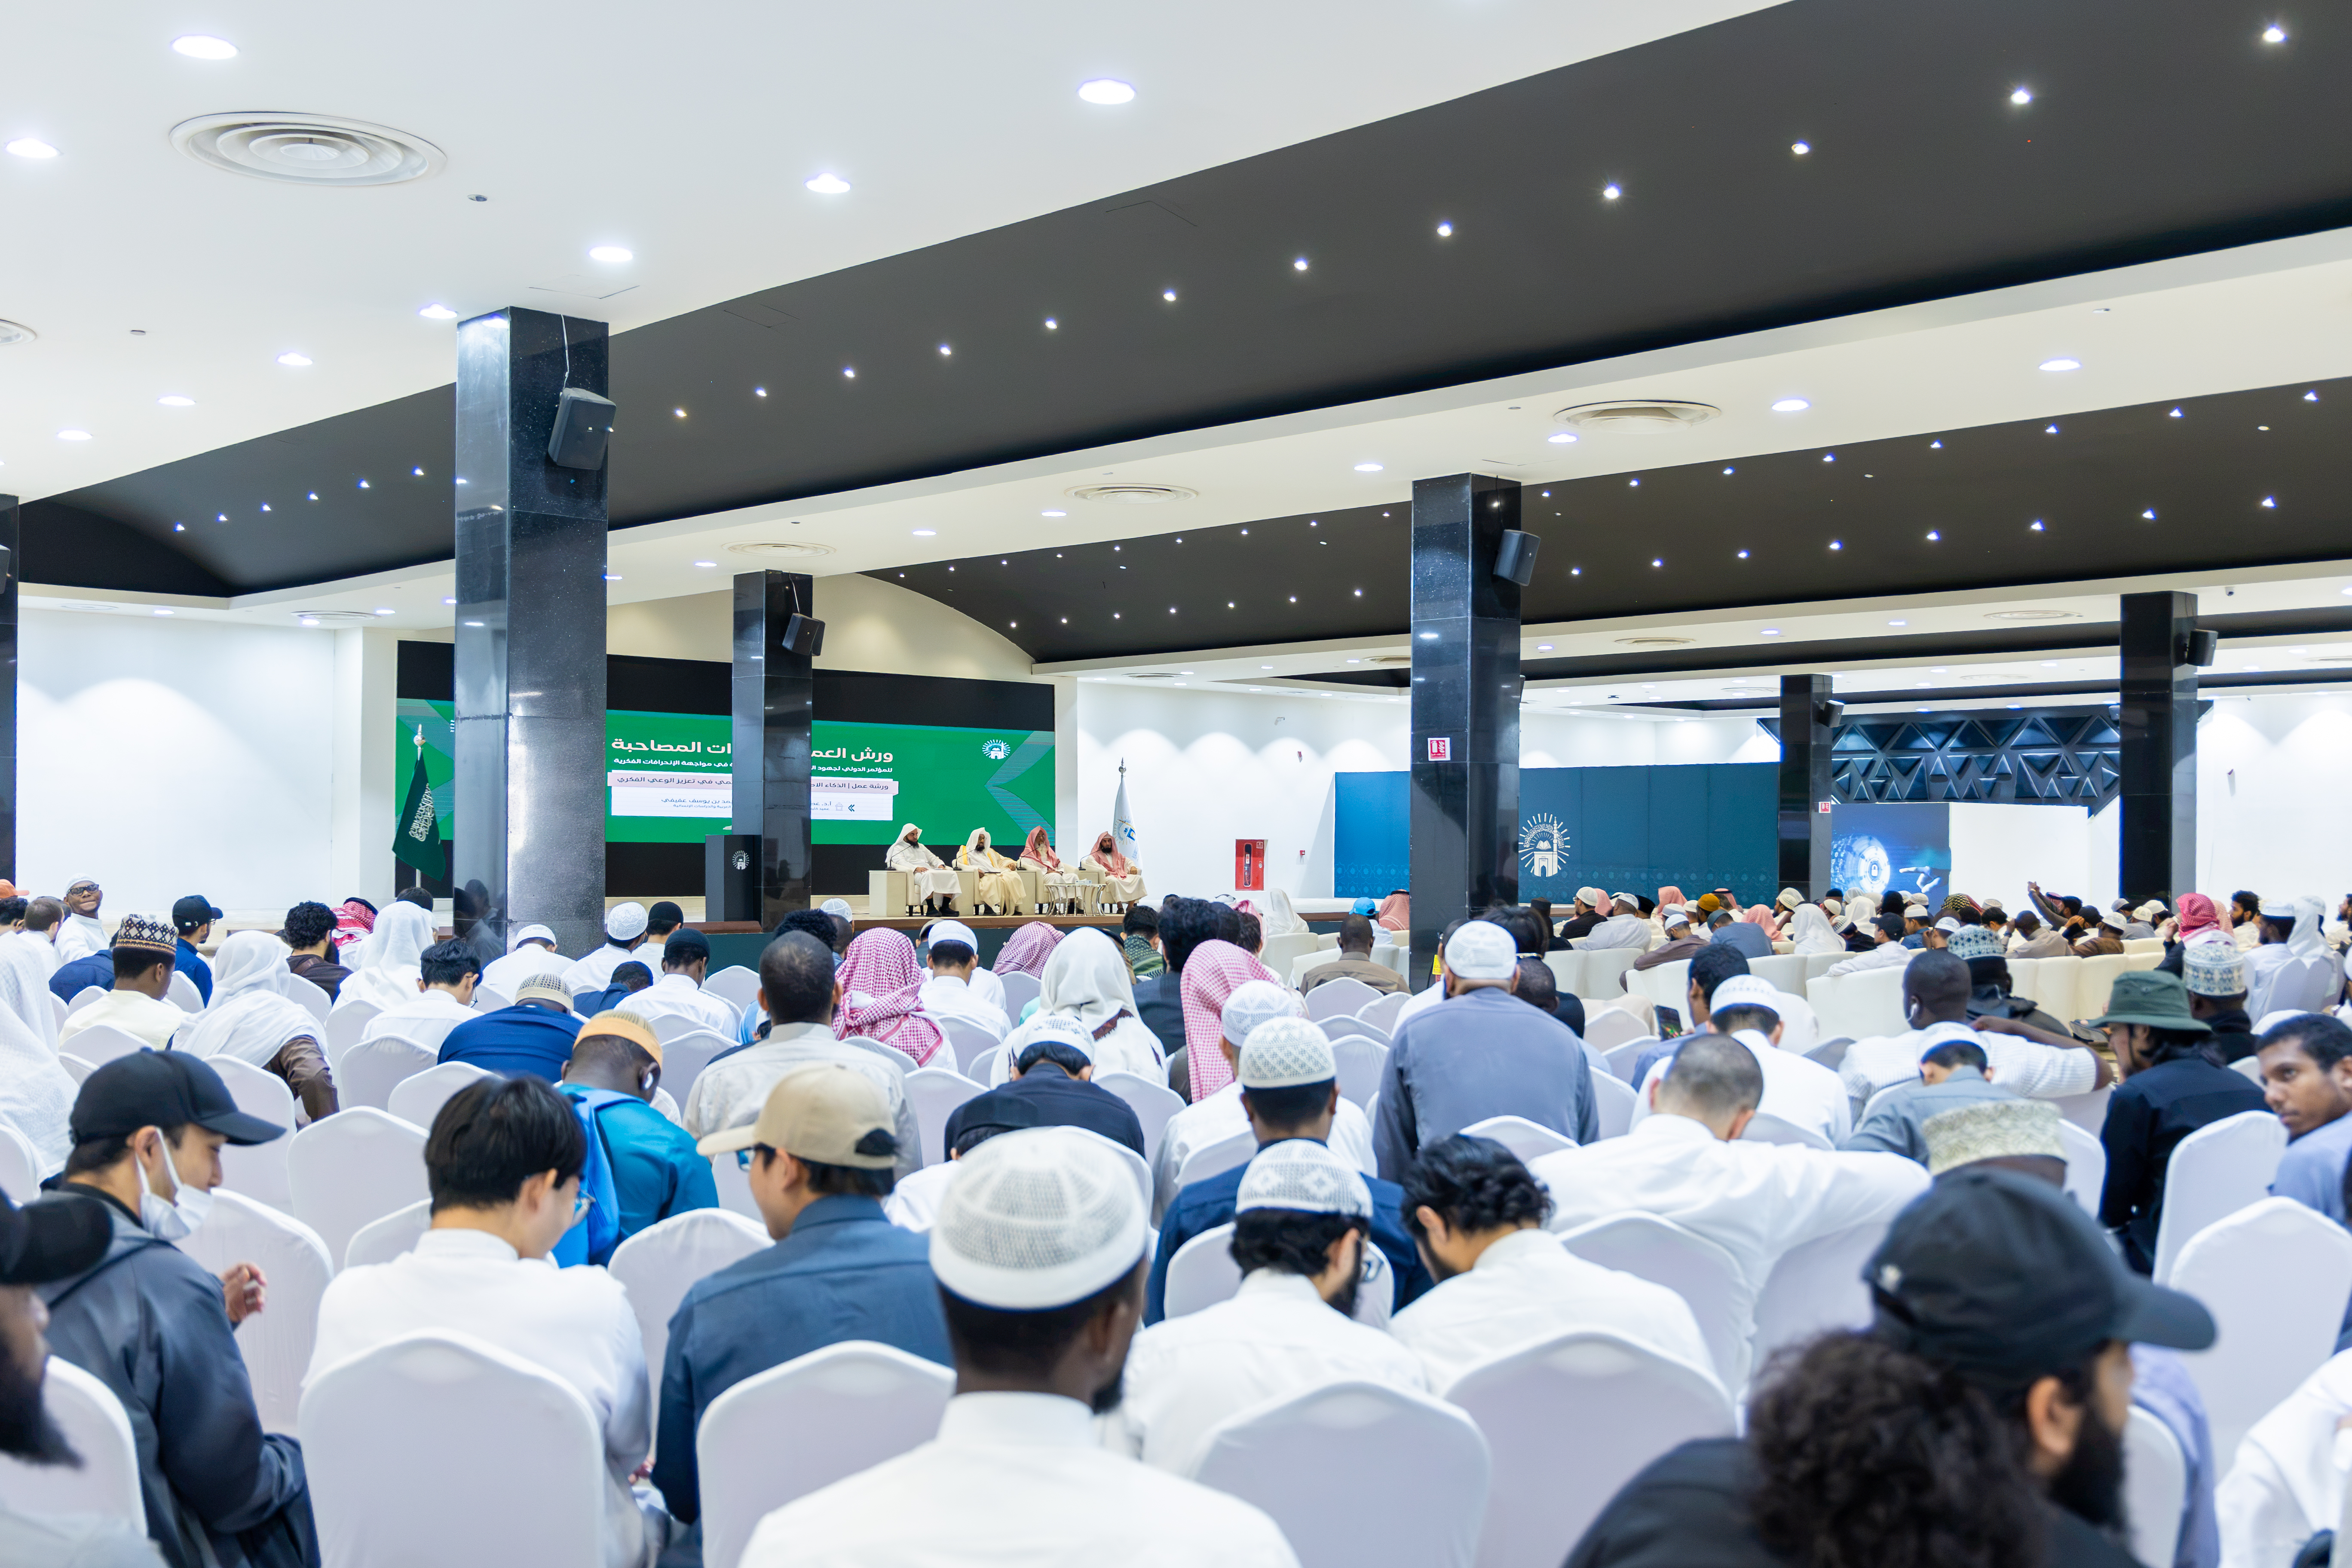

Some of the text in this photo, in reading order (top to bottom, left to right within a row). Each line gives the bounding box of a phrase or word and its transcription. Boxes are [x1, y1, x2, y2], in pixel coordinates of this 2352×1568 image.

[611, 738, 701, 753] المصاحبة
[811, 747, 846, 759] العم
[851, 747, 893, 763] ورش
